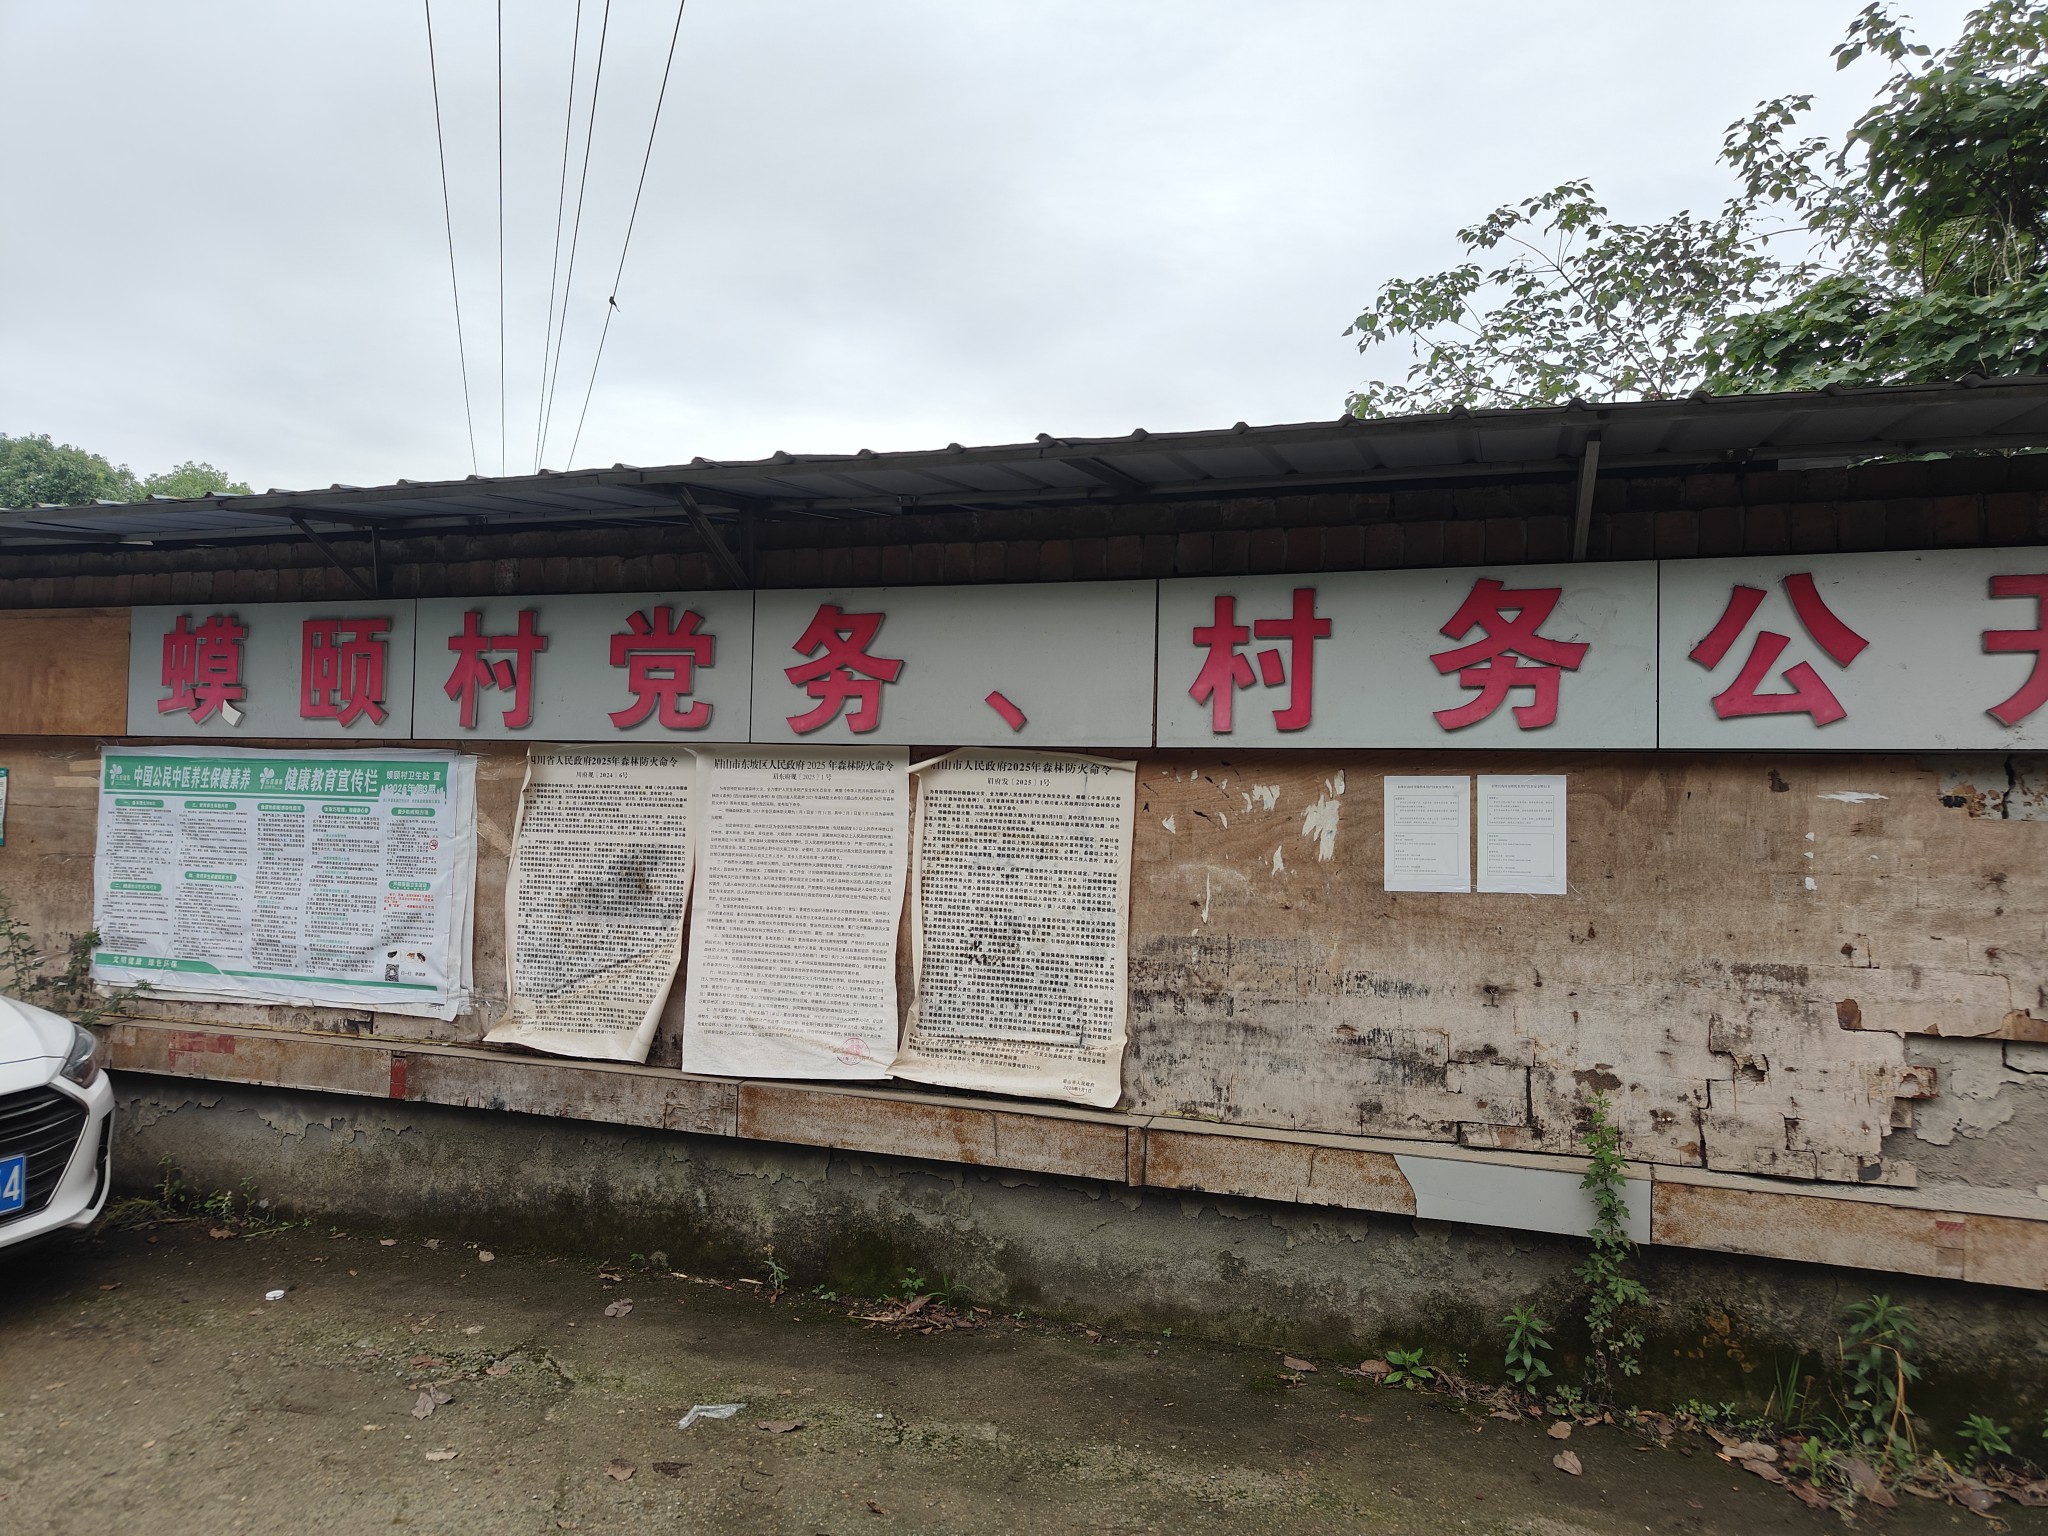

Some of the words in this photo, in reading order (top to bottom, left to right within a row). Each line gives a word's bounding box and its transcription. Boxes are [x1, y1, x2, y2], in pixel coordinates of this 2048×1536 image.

[133, 764, 252, 791] 中国公民中医养生保健素养
[283, 766, 378, 793] 健康教育宣传栏
[0, 1165, 20, 1202] 4
